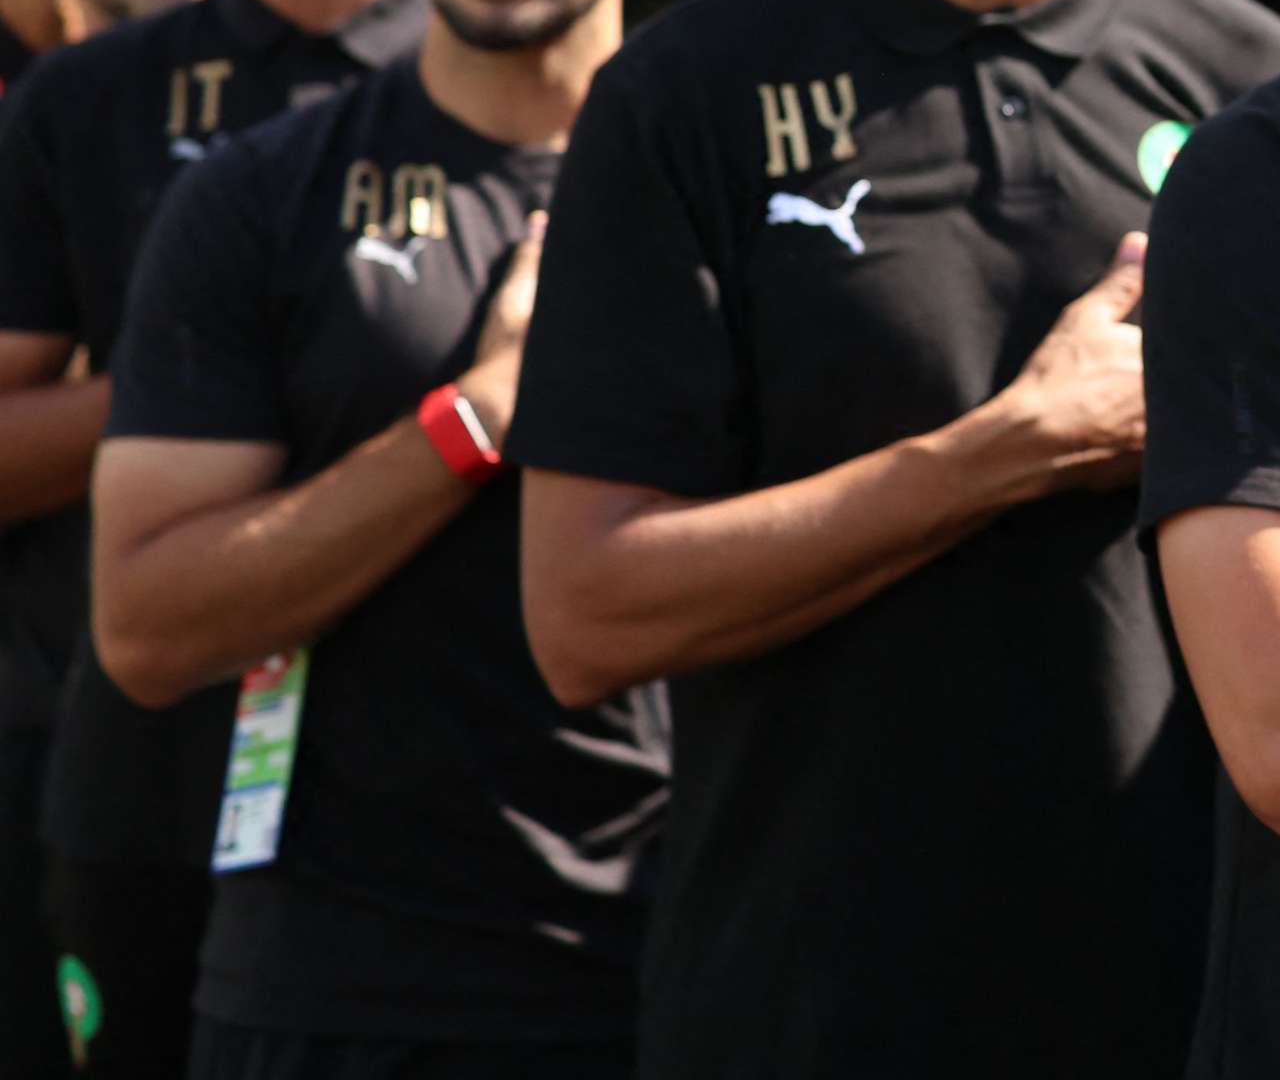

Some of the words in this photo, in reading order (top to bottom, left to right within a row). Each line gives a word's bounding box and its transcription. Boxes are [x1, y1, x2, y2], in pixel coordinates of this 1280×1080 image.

[167, 60, 233, 136] IT
[757, 72, 857, 178] HY
[342, 159, 447, 239] AM
